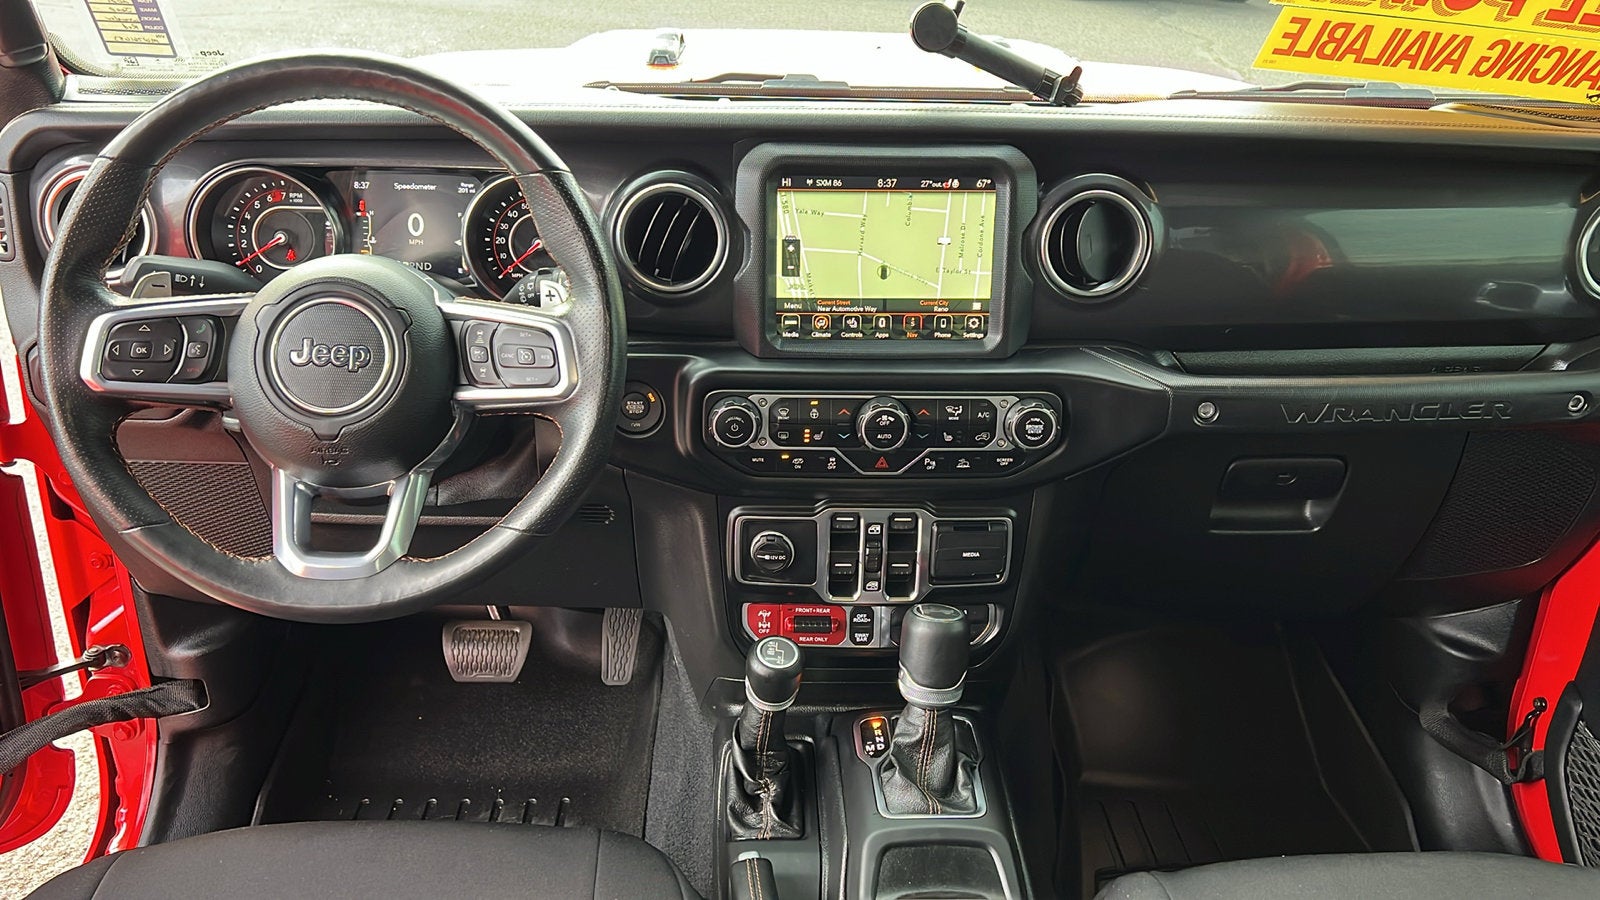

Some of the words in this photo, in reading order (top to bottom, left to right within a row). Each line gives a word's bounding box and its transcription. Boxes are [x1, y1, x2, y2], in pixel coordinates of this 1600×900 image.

[394, 182, 437, 191] Speedometer
[782, 178, 792, 187] HI
[816, 179, 832, 187] SXM
[832, 179, 842, 187] 86
[877, 178, 898, 188] 8:37
[244, 212, 251, 220] 4
[810, 208, 825, 217] Way
[407, 212, 424, 236] 0
[500, 222, 509, 230] 30
[240, 225, 247, 234] 3
[240, 240, 248, 248] 2
[255, 264, 262, 273] 0
[962, 332, 985, 340] Settings
[290, 338, 372, 374] Jeep
[1280, 401, 1514, 424] WRANGLER
